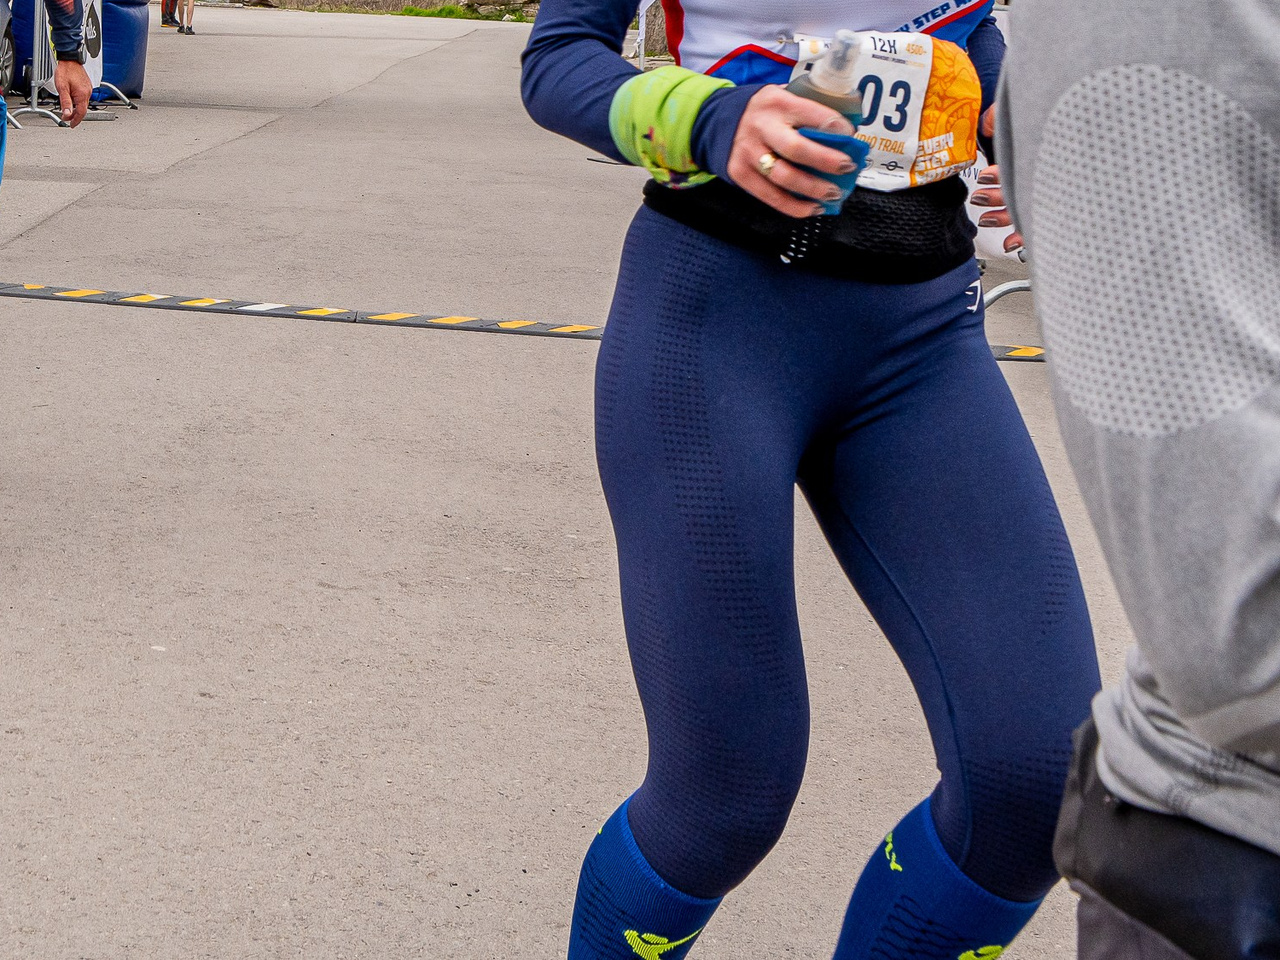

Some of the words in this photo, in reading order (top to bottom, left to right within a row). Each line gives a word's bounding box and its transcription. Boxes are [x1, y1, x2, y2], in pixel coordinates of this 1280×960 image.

[913, 2, 951, 29] STEP
[870, 36, 898, 55] 12H
[878, 137, 906, 155] TRAIL
